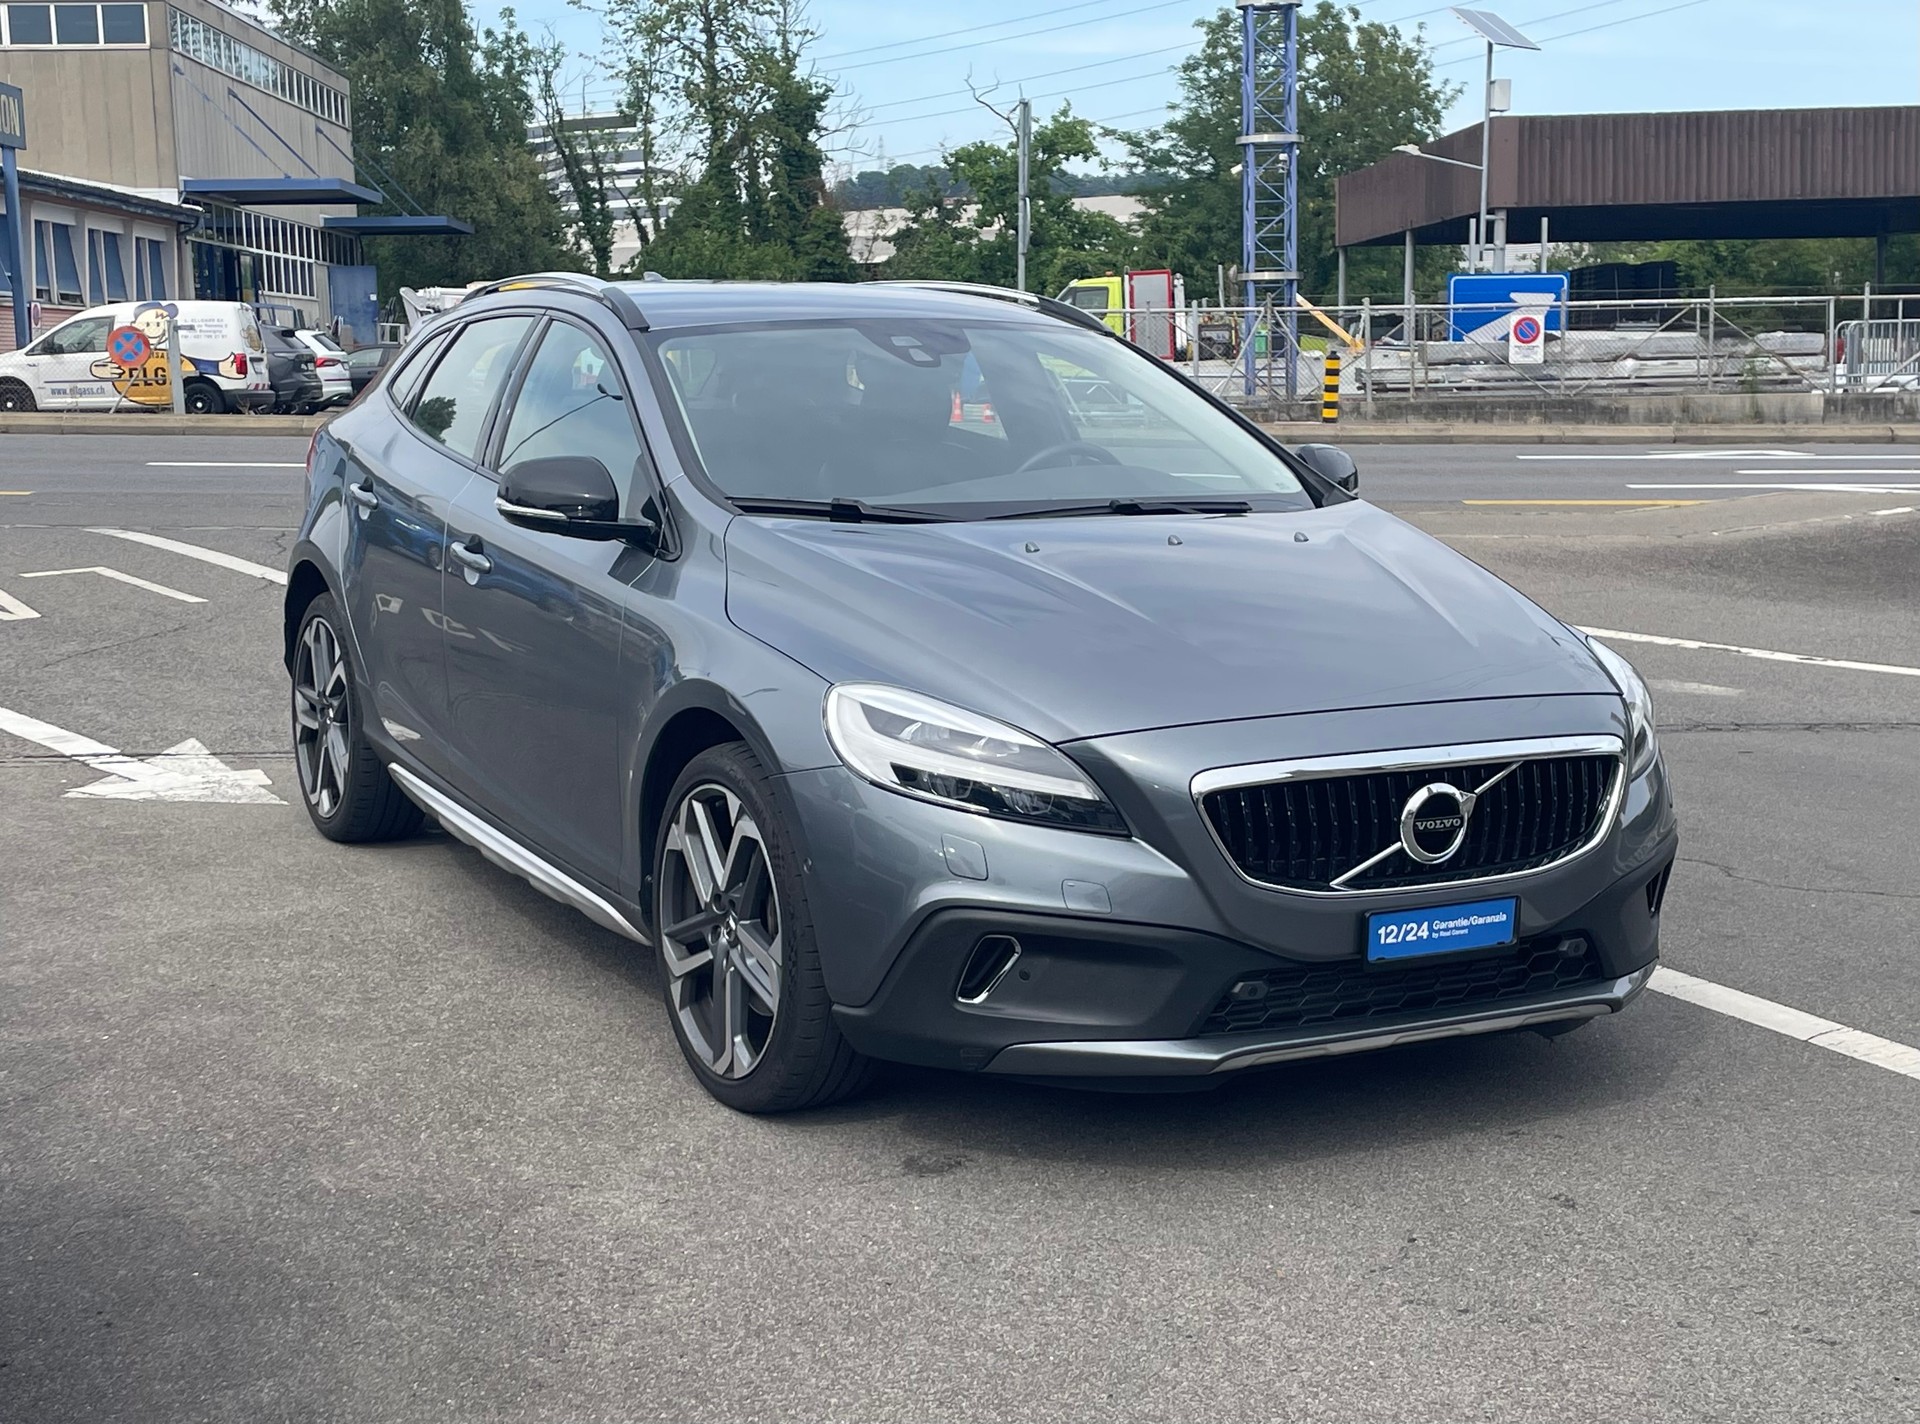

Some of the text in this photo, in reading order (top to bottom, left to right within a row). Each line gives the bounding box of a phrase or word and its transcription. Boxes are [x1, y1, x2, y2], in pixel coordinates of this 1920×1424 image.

[0, 94, 20, 137] ON
[128, 367, 172, 387] ELG
[1415, 818, 1461, 830] VOLVO
[1432, 911, 1507, 930] Garantie/Garanzia
[1377, 921, 1429, 945] 12/24
